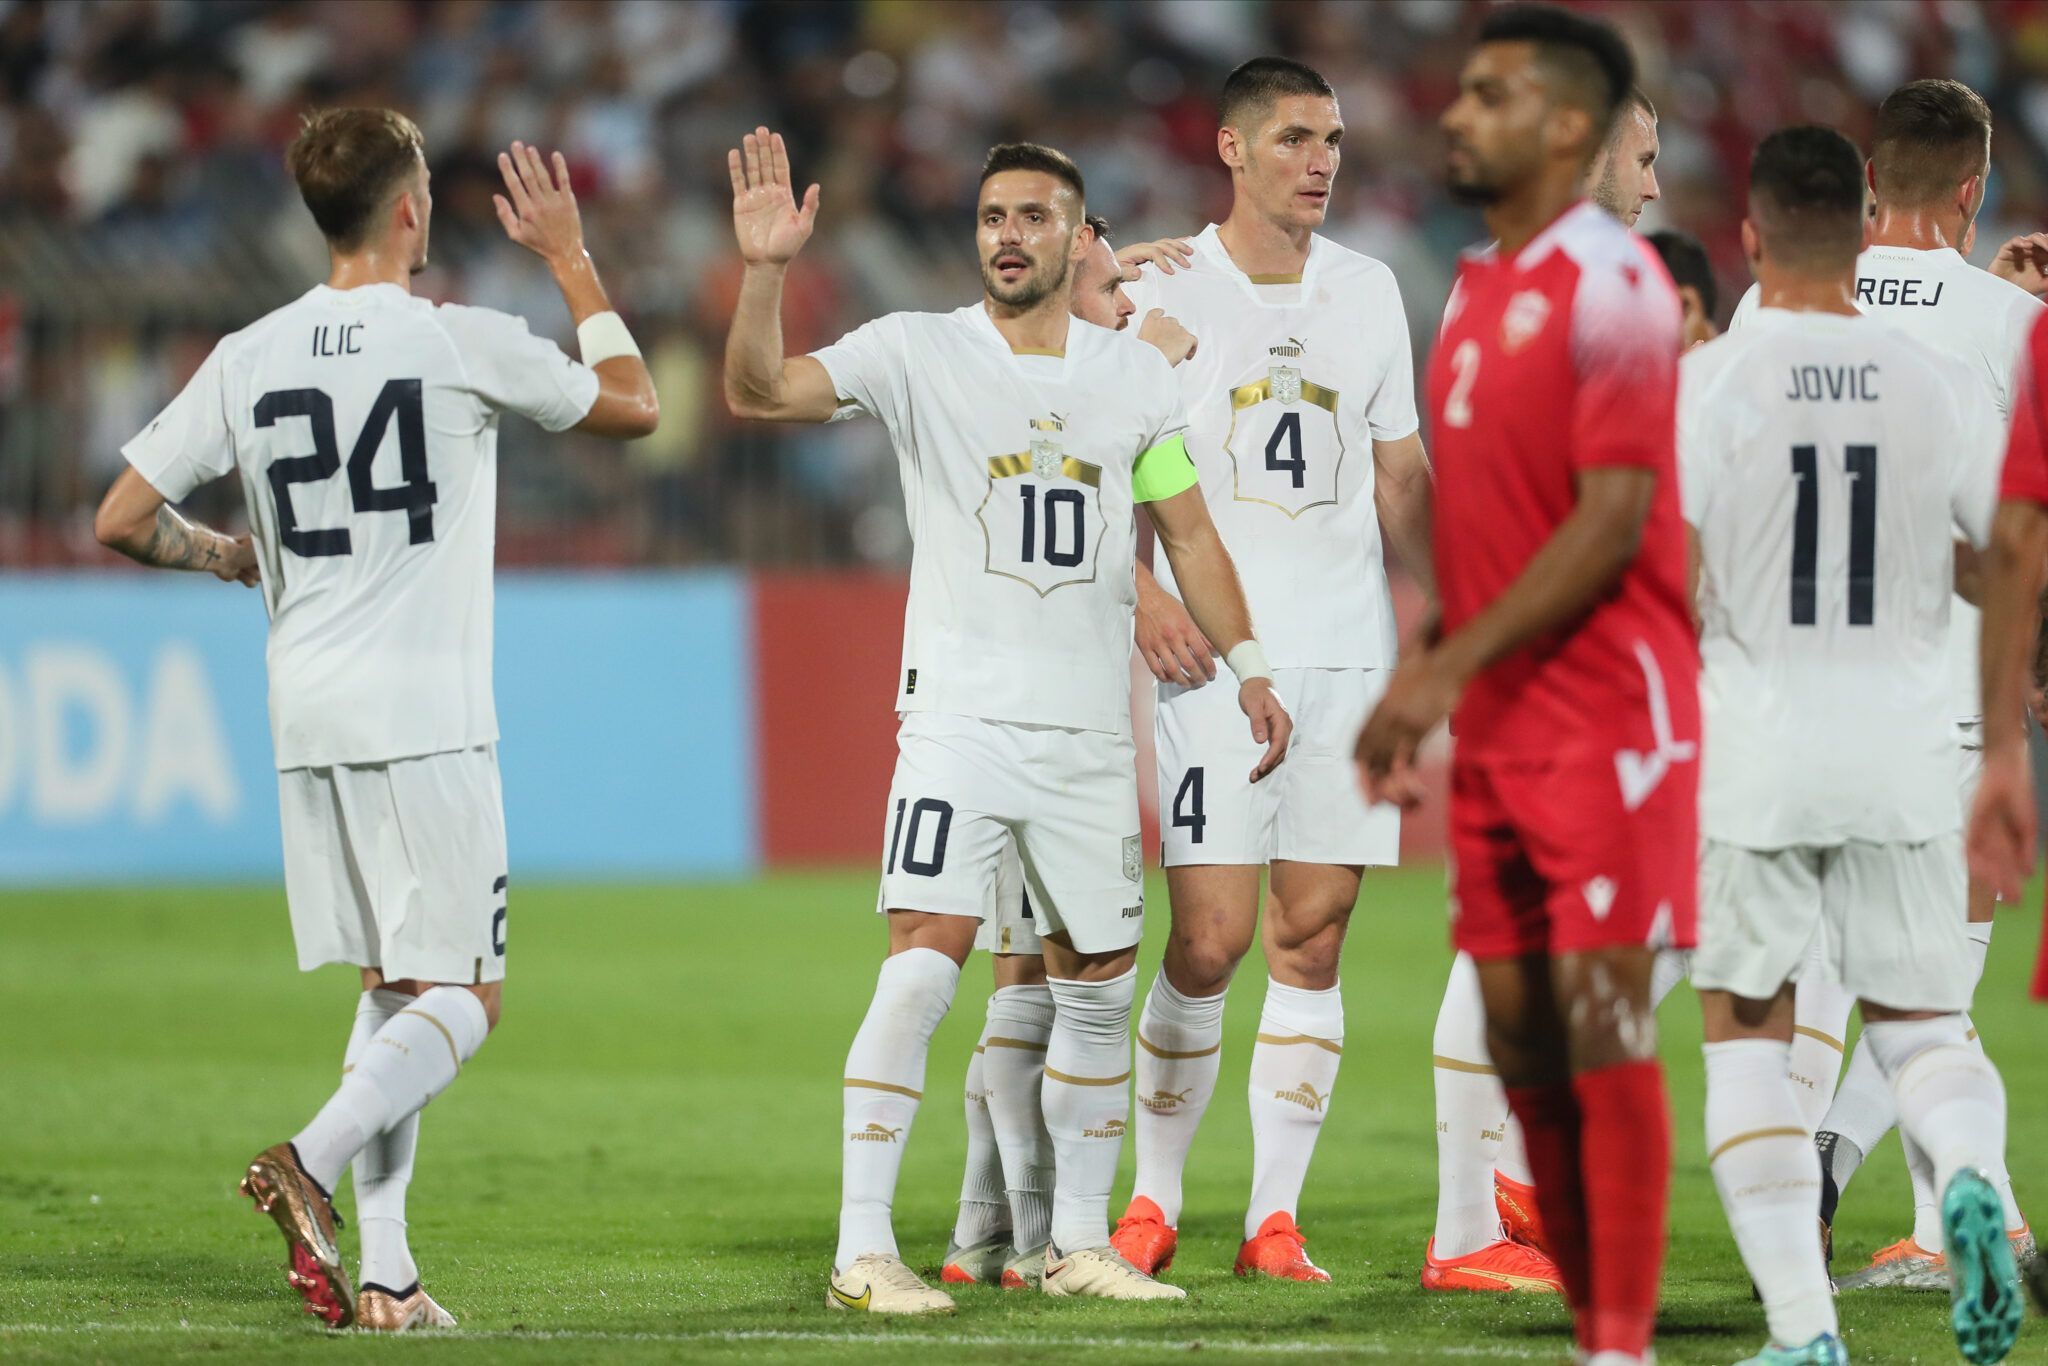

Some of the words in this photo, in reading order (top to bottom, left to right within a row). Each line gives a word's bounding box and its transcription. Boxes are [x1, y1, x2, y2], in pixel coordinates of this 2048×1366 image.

[1855, 277, 1944, 307] RGEJ
[1268, 345, 1301, 358] PUMA
[1443, 339, 1482, 428] 2
[1786, 360, 1880, 401] JOVIĆ
[1029, 418, 1063, 432] PUA
[1264, 412, 1307, 489] 4
[253, 378, 438, 557] 24
[1020, 484, 1085, 567] 10
[1790, 445, 1877, 625] 11
[0, 645, 238, 822] DA
[887, 797, 954, 878] 10
[1172, 766, 1207, 844] 4
[1121, 904, 1143, 919] PUM
[849, 1132, 890, 1143] PUMA
[1273, 1089, 1316, 1112] PUMA
